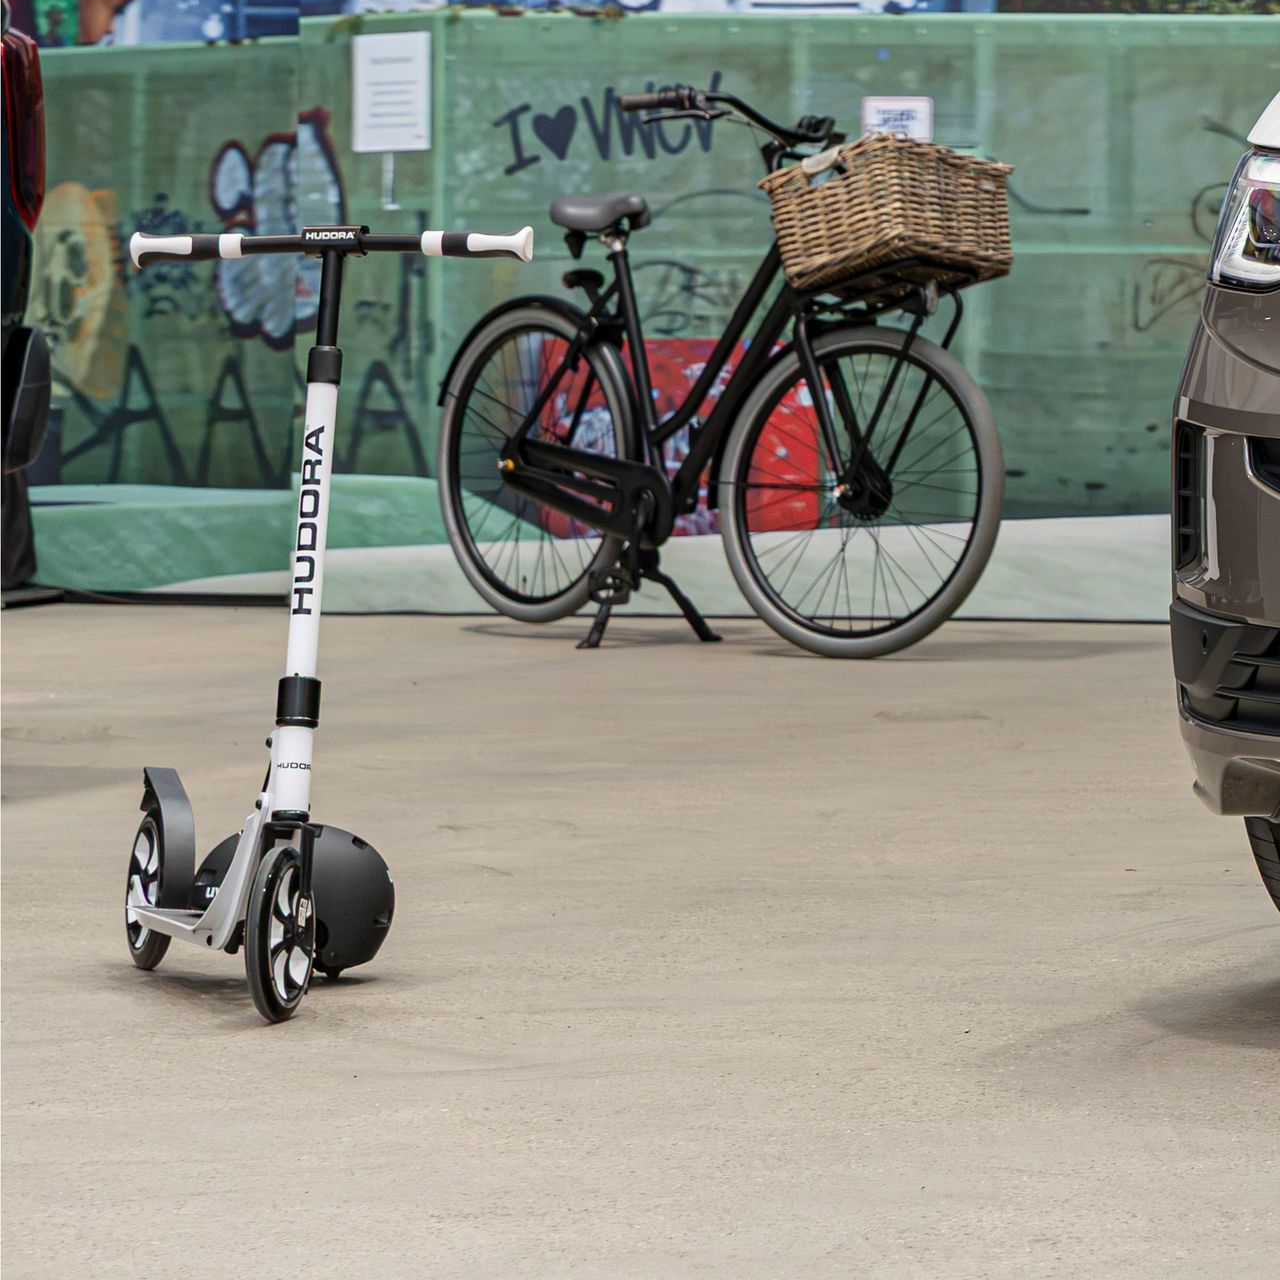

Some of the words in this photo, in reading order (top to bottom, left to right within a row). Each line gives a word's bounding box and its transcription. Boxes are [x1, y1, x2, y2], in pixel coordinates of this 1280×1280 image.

[493, 102, 541, 176] I
[305, 231, 355, 240] HUDORA
[292, 424, 326, 616] HUDORA
[277, 762, 312, 771] HUDOR
